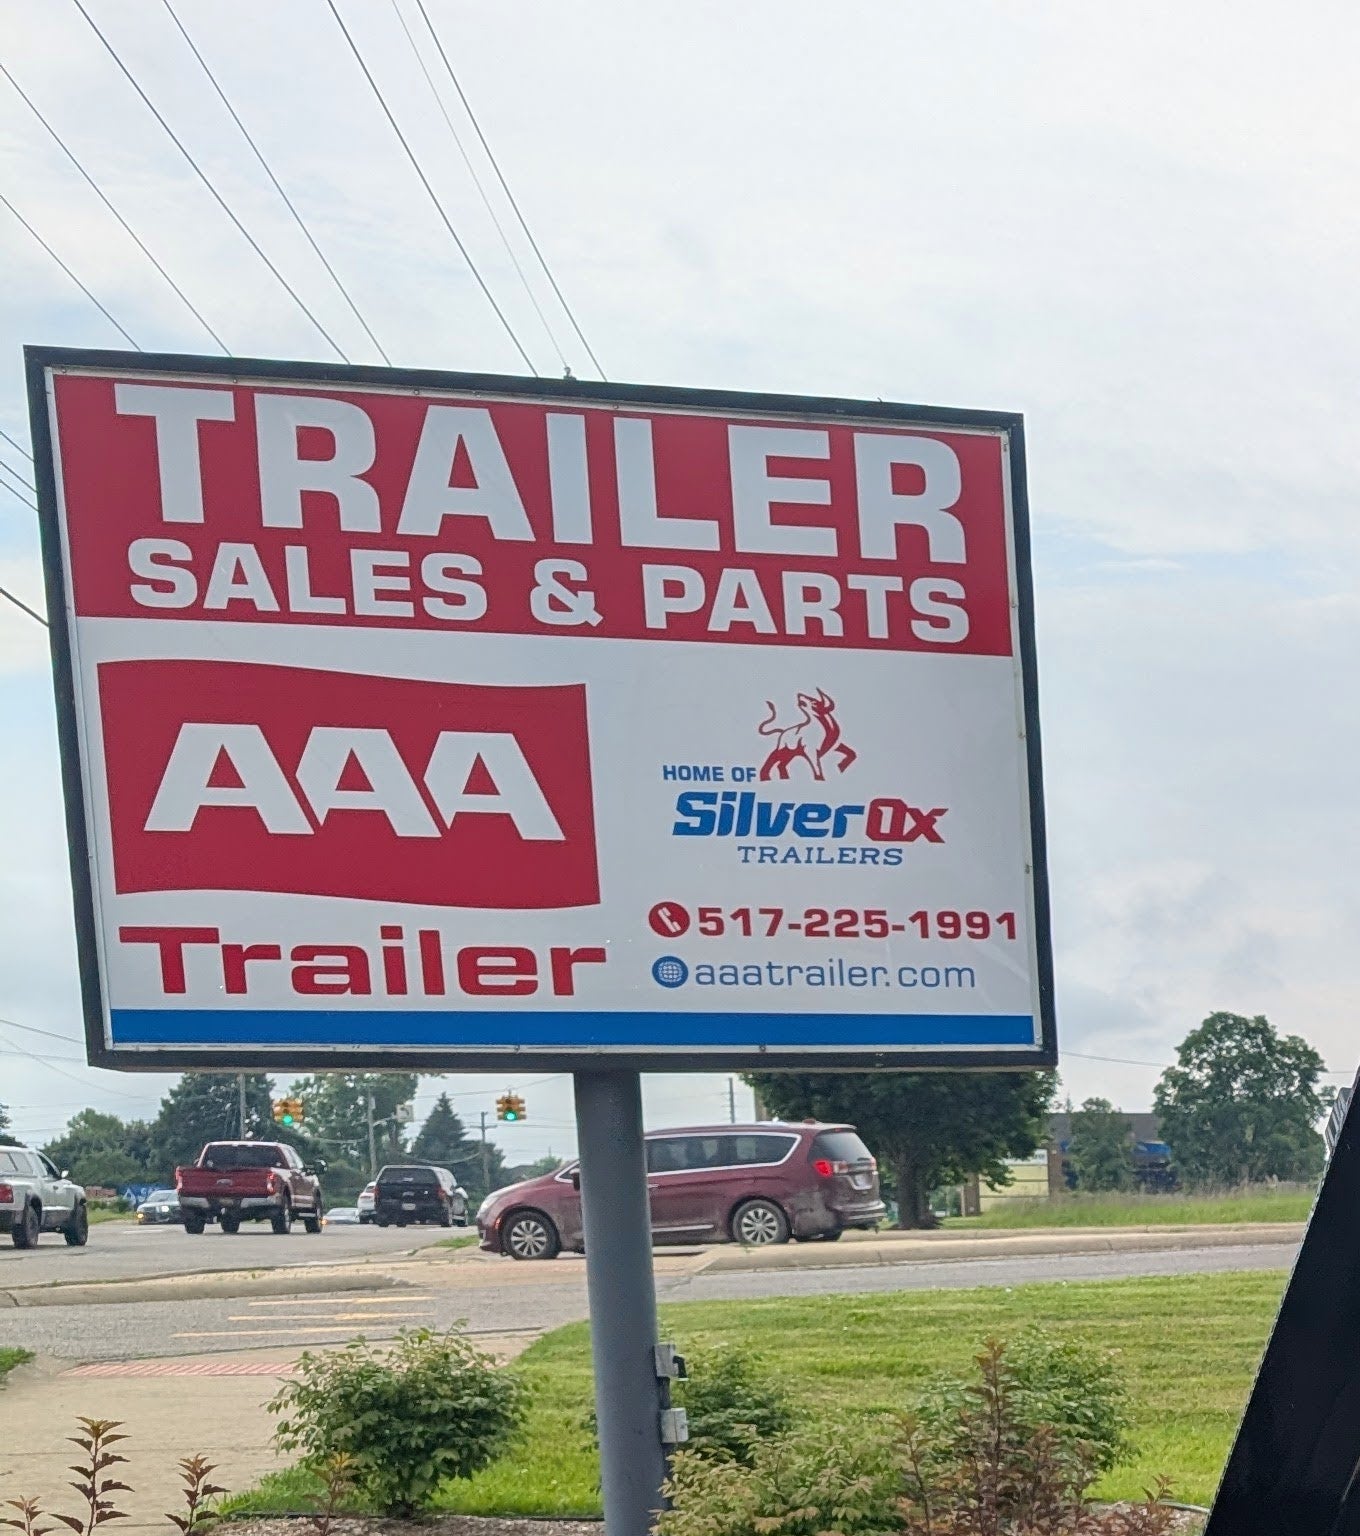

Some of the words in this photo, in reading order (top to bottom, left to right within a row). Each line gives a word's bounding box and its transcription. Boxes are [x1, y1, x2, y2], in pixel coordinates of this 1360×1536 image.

[114, 383, 967, 564] TRAILER
[127, 537, 488, 621] SALES
[529, 559, 603, 627] &
[643, 564, 969, 643] PARTS
[144, 723, 566, 841] AAA
[662, 764, 725, 783] HOME
[730, 766, 757, 783] OF
[738, 844, 903, 867] TRAILERS
[699, 907, 1016, 940] 517-225-1991
[119, 926, 607, 996] Trailer
[695, 959, 976, 989] aaatrailer.com
